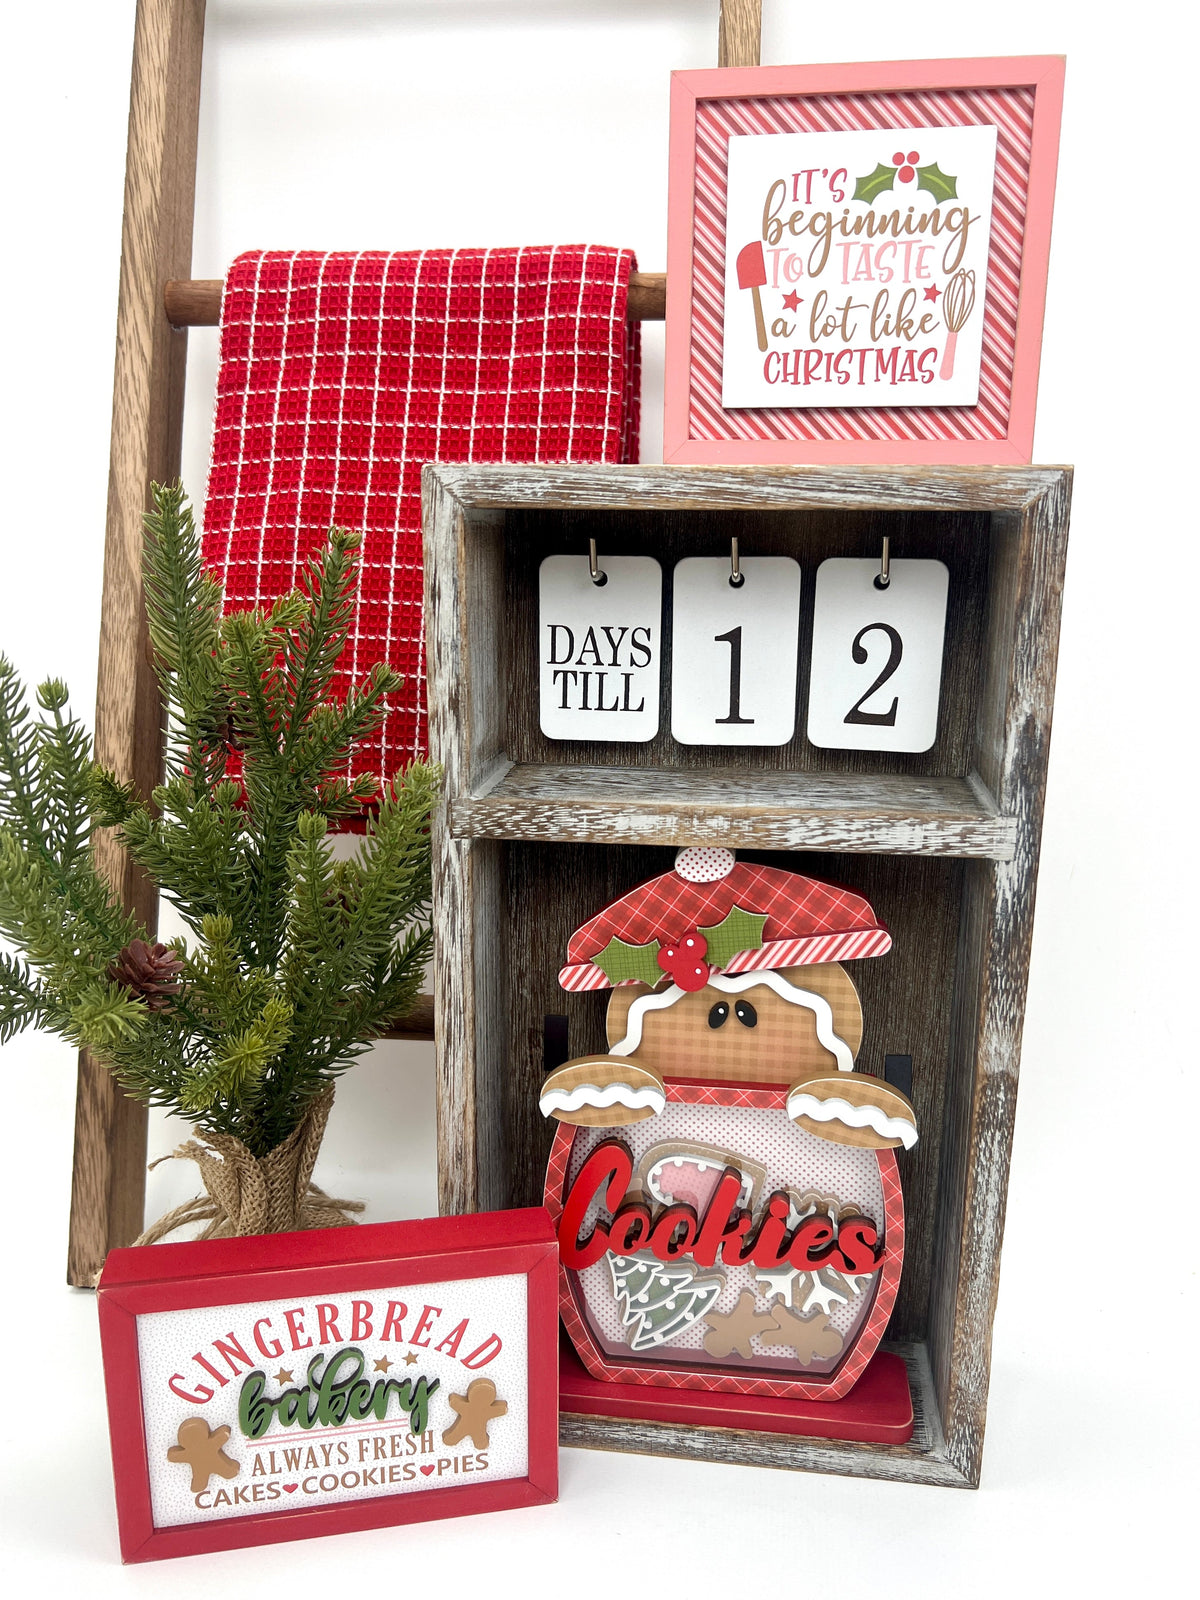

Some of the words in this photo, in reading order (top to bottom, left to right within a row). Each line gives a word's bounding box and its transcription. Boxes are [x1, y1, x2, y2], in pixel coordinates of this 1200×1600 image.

[792, 168, 847, 204] IT'S
[762, 179, 981, 277] beginning
[766, 248, 803, 288] TO
[836, 240, 935, 284] TASTE
[771, 318, 796, 338] a
[810, 290, 869, 343] lot
[871, 288, 940, 342] like
[763, 346, 937, 385] CHRISTMAS
[546, 624, 652, 667] DAYS
[553, 670, 644, 711] TILL
[715, 626, 754, 724] 1
[843, 622, 903, 727] 2
[558, 1136, 887, 1275] Cookies
[168, 1300, 503, 1405] GINGERBREAD
[238, 1346, 440, 1440] bakery
[194, 1481, 282, 1509] CAKES
[302, 1462, 417, 1495] COOKIES
[437, 1453, 489, 1476] PIES
[251, 1441, 350, 1477] ALWAYS
[358, 1430, 435, 1462] FRESH
